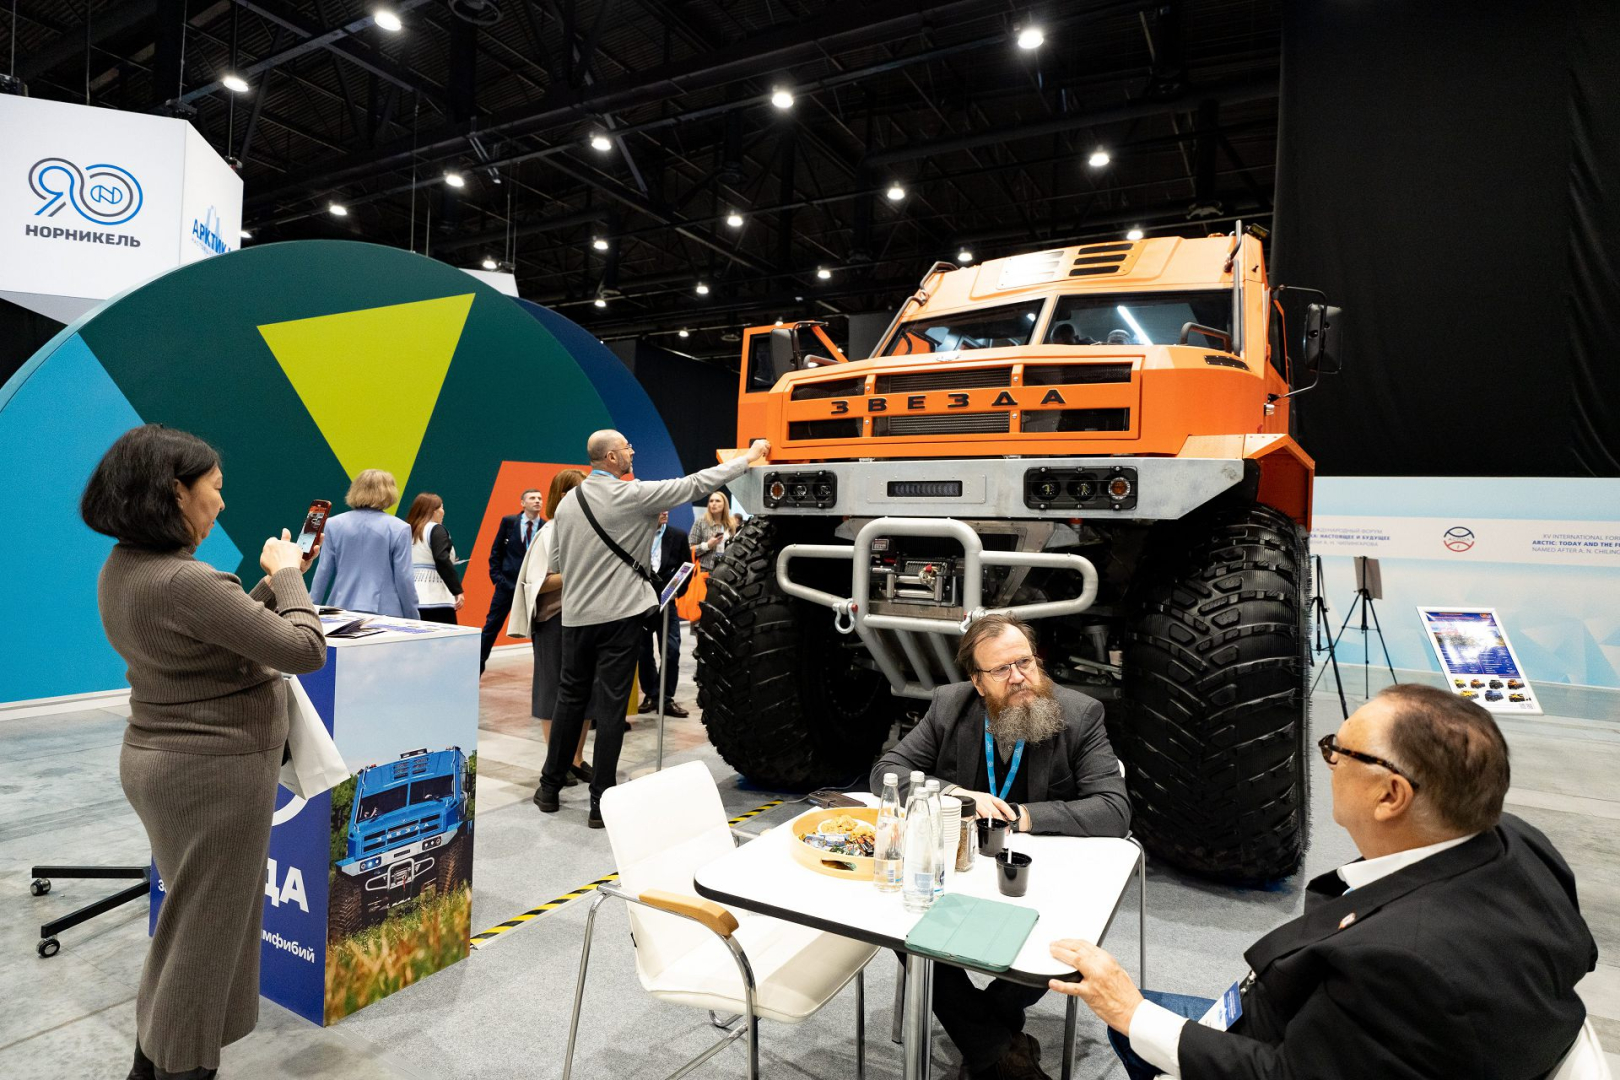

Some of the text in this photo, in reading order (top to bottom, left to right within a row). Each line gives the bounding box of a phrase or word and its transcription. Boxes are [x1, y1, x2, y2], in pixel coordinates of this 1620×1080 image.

[25, 224, 141, 248] НОРНИКЕЛЬ
[831, 389, 1066, 415] ЗВЕЗДА
[261, 930, 315, 964] мфибий
